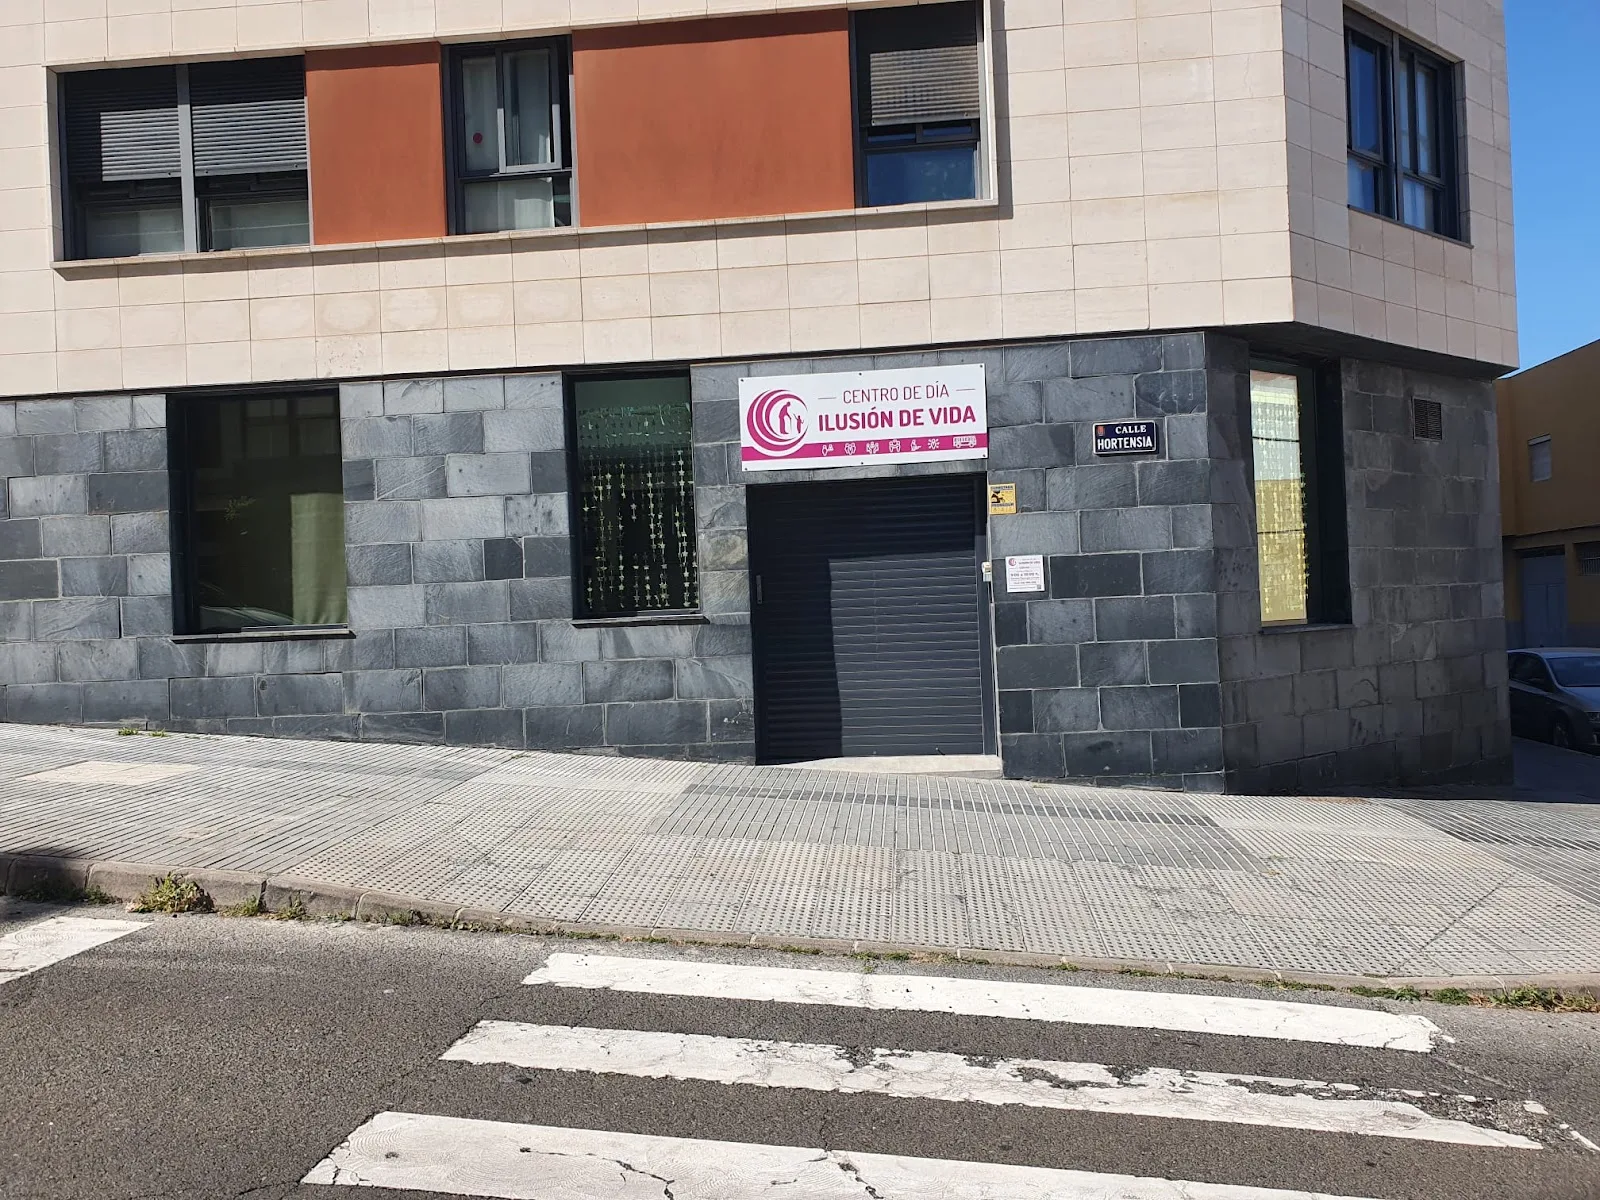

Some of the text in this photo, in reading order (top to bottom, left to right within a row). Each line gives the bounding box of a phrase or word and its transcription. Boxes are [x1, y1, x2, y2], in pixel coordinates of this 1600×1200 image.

[843, 381, 949, 404] CENTRO DE DÍA
[818, 405, 976, 431] ILUSIÓN DE VIDA
[1115, 424, 1147, 434] CALLE
[1097, 436, 1153, 450] HORTENSIA
